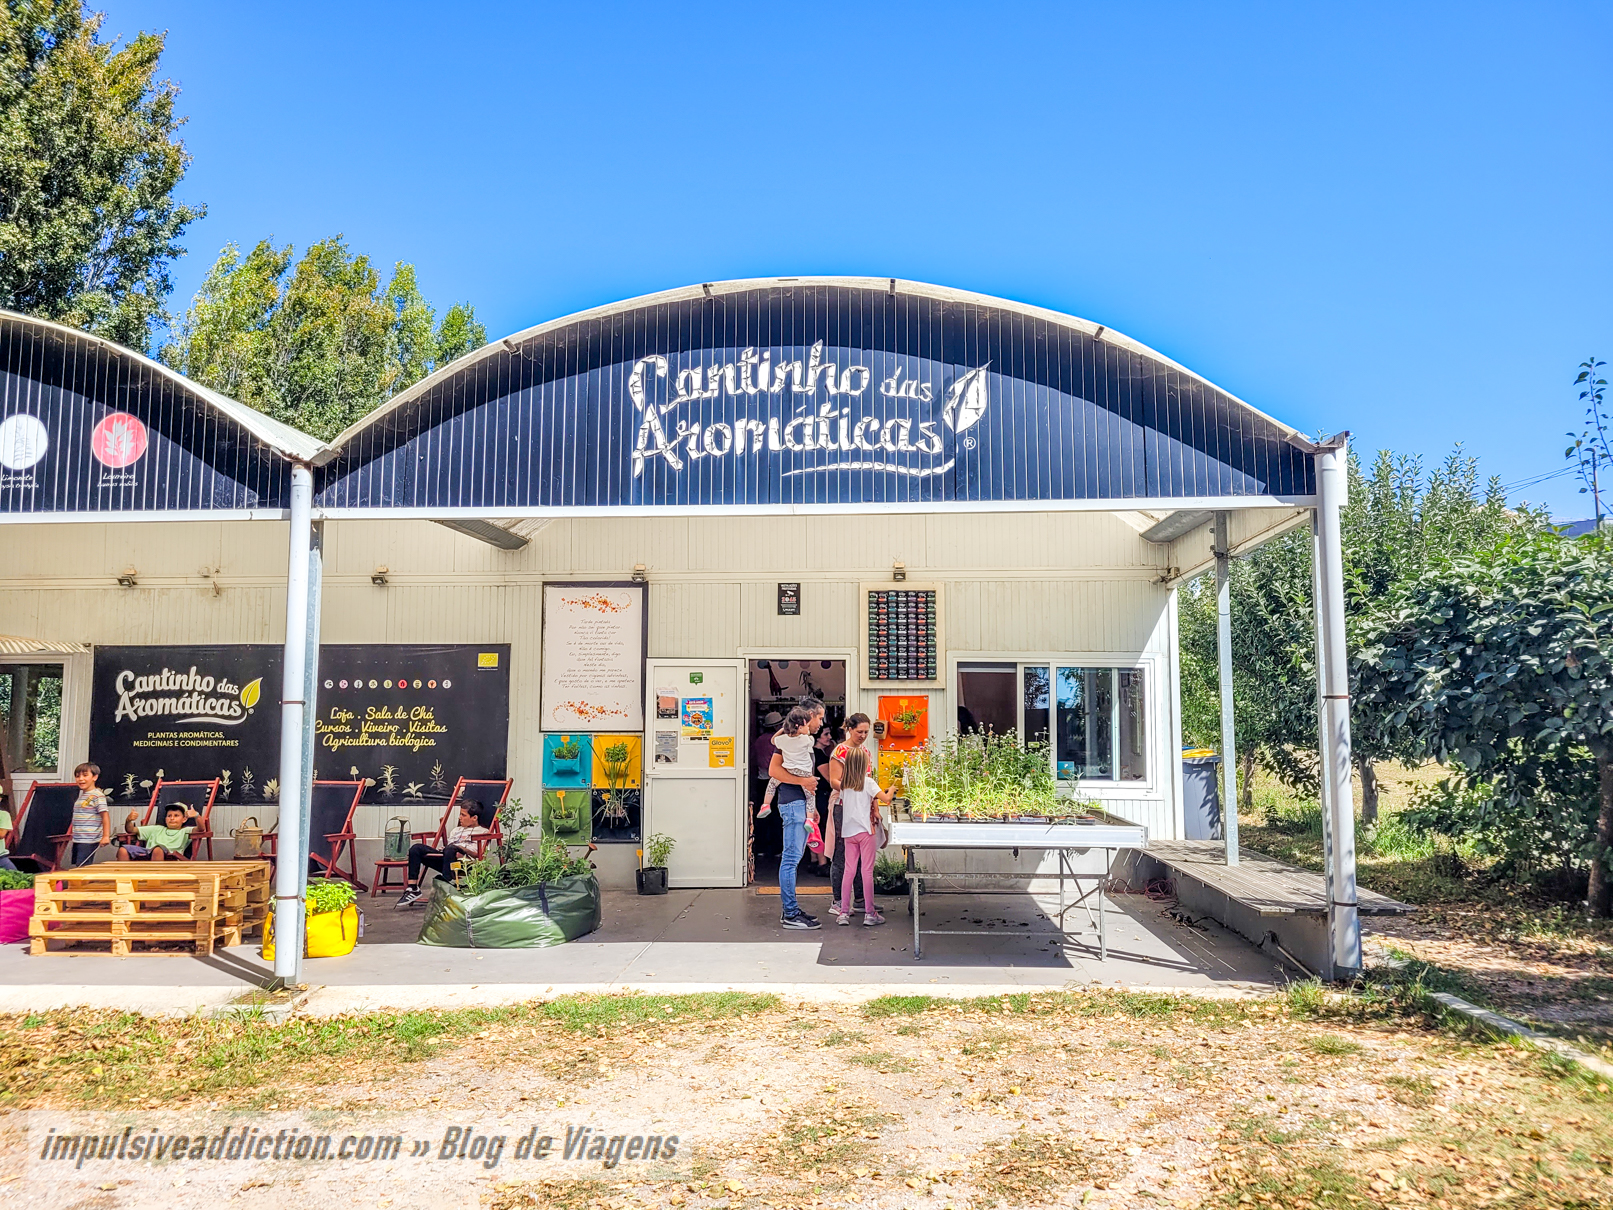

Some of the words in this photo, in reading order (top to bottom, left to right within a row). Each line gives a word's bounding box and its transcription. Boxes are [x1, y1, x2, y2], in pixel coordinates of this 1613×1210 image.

[629, 339, 870, 414] Cantinho
[880, 366, 933, 402] das
[633, 402, 943, 478] Aromáticas
[102, 472, 135, 480] Loureiro
[116, 666, 215, 698] Cantinho
[217, 678, 239, 695] das
[115, 690, 242, 723] Aromáticas
[330, 706, 355, 723] Loja
[365, 705, 393, 720] Sala
[394, 705, 409, 720] de
[410, 705, 435, 720] Chá
[179, 730, 225, 740] AROMÁTICAS,
[314, 719, 352, 734] Cursos
[361, 720, 401, 733] Viveiro
[409, 719, 448, 733] Visitas
[322, 732, 388, 752] Agricultura
[388, 732, 437, 752] biológica
